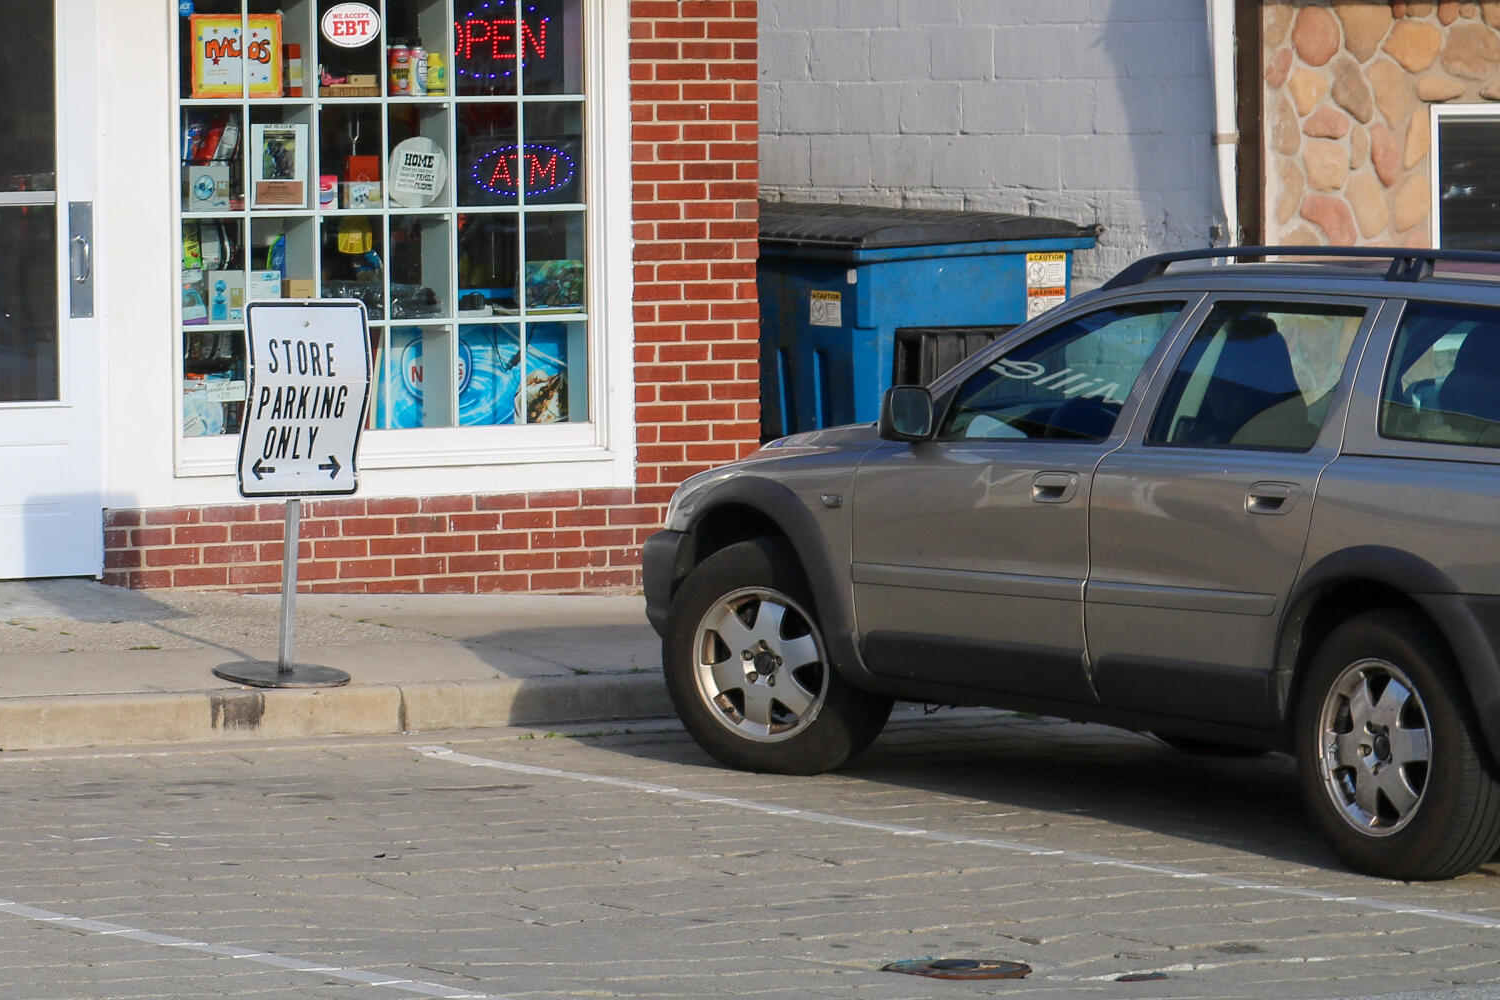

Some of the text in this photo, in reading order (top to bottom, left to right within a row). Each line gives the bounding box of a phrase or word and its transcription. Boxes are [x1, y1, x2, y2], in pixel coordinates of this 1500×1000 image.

[333, 20, 370, 36] EBT
[404, 152, 435, 168] HOME
[490, 154, 557, 186] ATM
[1034, 288, 1064, 296] WARNING
[268, 338, 336, 377] STORE
[257, 385, 348, 420] PARKING
[263, 426, 318, 460] ONLY
